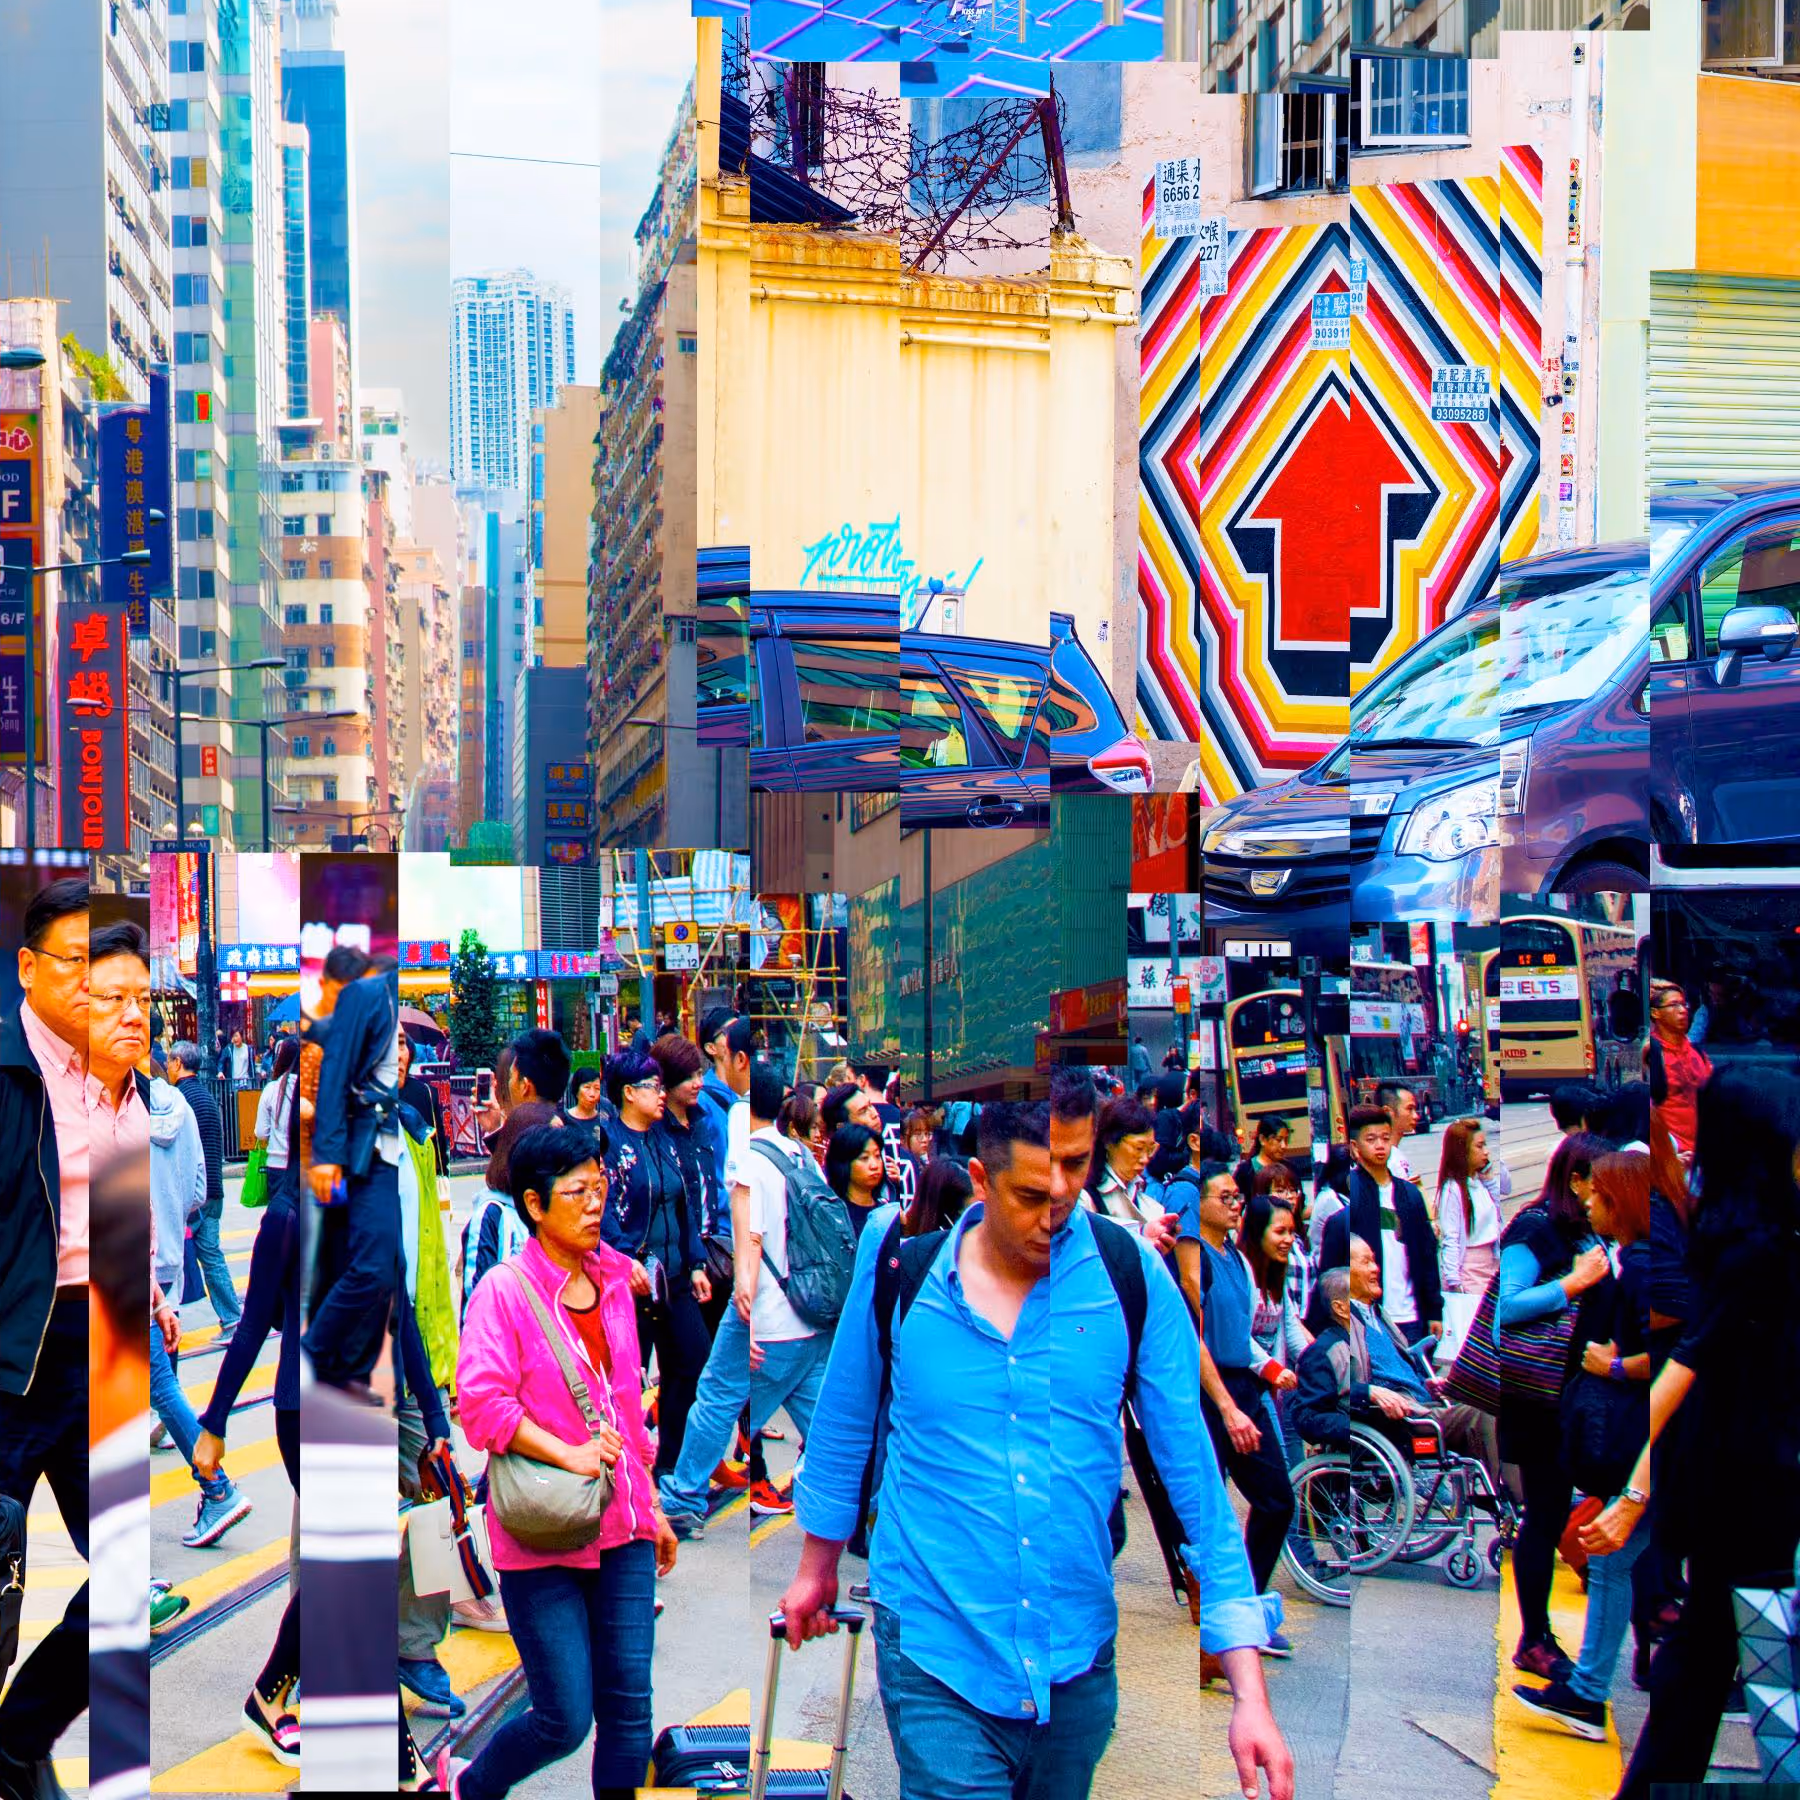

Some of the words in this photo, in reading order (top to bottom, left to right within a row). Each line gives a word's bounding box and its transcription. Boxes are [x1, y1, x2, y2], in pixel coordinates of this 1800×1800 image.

[1163, 186, 1189, 202] 6656
[1437, 409, 1484, 420] 93095288
[2, 490, 20, 518] F
[79, 730, 104, 849] BONJOUR
[686, 945, 692, 953] 7
[687, 959, 697, 967] 12
[1518, 980, 1560, 994] IELTS
[1505, 1049, 1527, 1058] KMB
